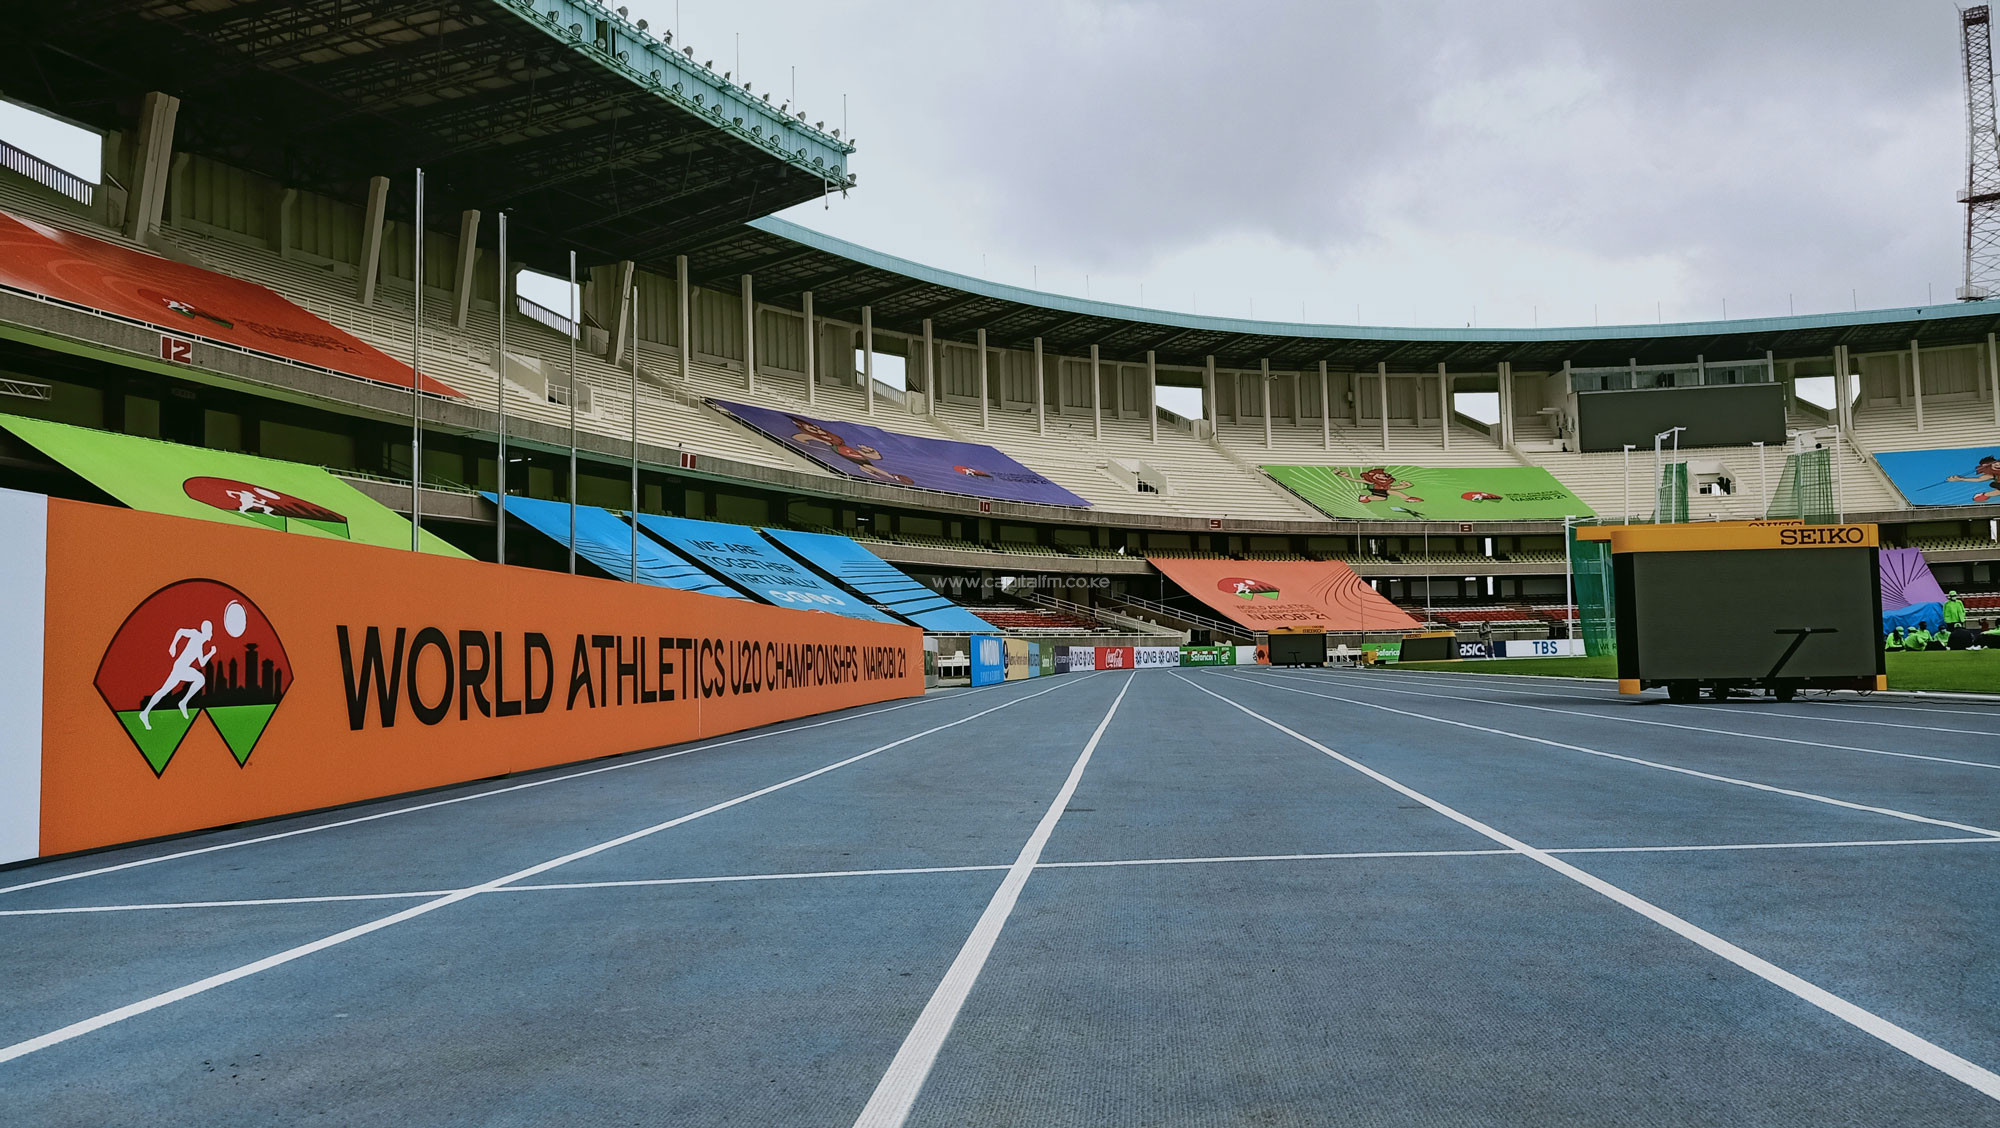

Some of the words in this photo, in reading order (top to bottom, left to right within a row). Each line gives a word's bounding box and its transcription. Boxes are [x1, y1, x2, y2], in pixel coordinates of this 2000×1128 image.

[161, 336, 192, 365] 12
[979, 500, 991, 512] 10
[1780, 527, 1864, 545] SEIKO
[685, 539, 727, 553] WE
[723, 542, 764, 557] ARE
[697, 554, 801, 575] TOGETHER
[724, 571, 824, 590] VIRTUALLY
[1246, 613, 1311, 621] NAIROBI
[1310, 613, 1332, 621] 21
[1532, 641, 1558, 655] TBS
[1142, 651, 1157, 664] QNB
[1165, 651, 1179, 664] QNB
[336, 625, 554, 731] WORLD
[566, 633, 725, 711] ATHLETICS
[730, 639, 762, 695] U20
[863, 646, 896, 681] NAIROBI
[897, 647, 907, 679] 21
